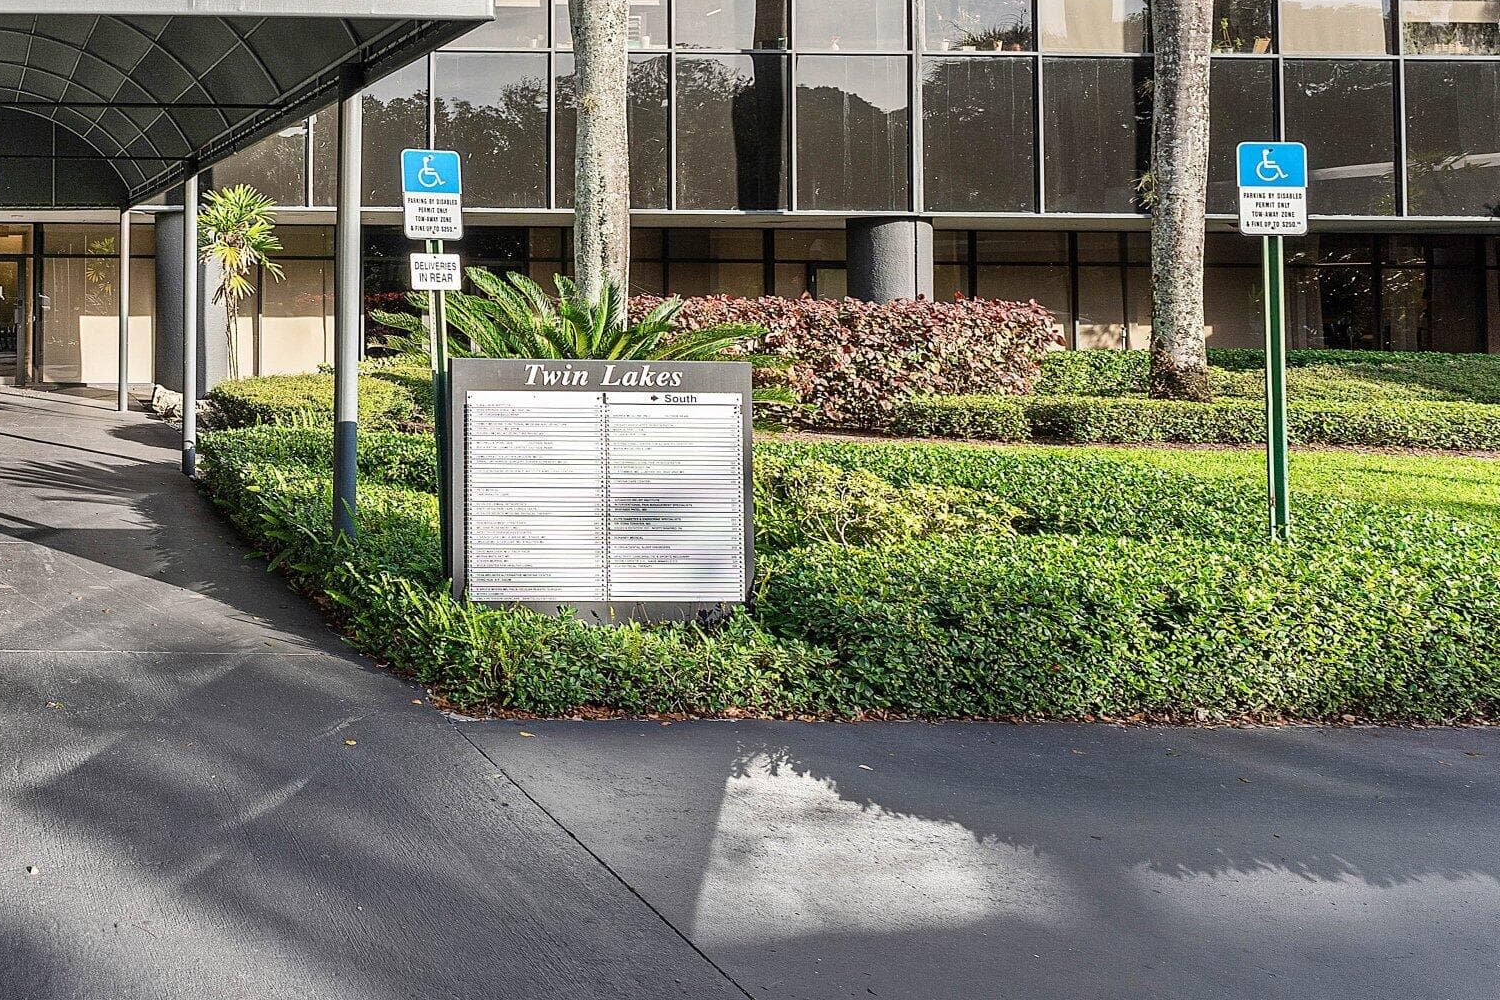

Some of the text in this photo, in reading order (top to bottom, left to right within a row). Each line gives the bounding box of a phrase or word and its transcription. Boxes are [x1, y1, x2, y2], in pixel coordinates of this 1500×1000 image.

[1277, 192, 1303, 200] DISABLED
[1251, 210, 1279, 218] TOW-AWAY
[414, 261, 457, 271] DELIVERIES
[419, 272, 453, 283] IN REAR
[524, 364, 684, 387] Twin Lakes
[664, 394, 697, 403] South
